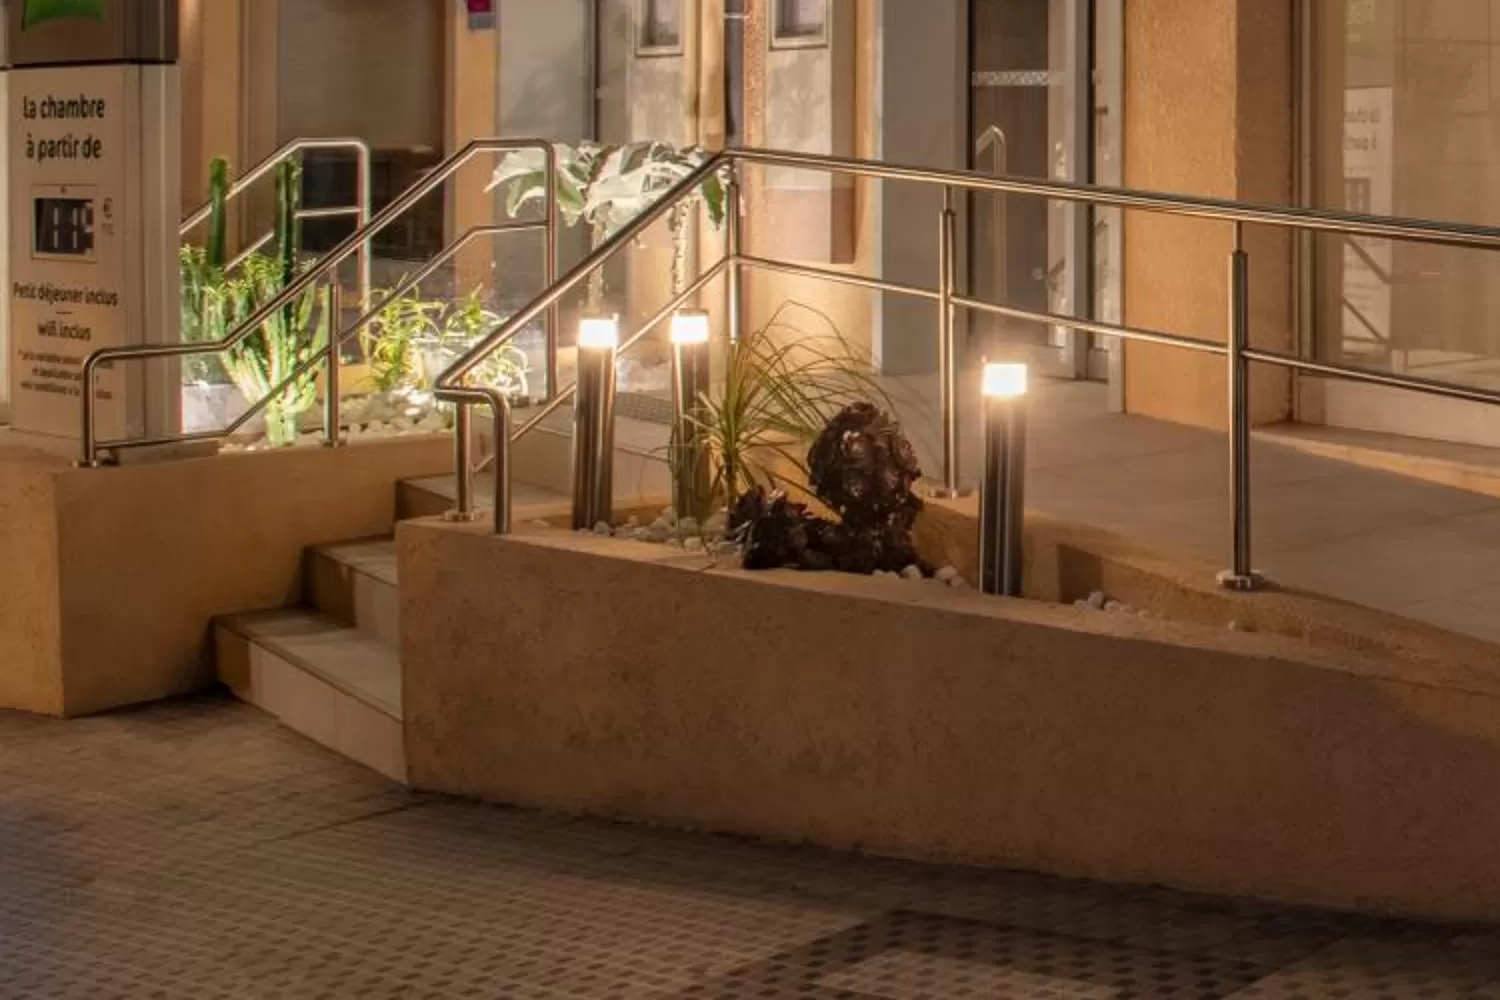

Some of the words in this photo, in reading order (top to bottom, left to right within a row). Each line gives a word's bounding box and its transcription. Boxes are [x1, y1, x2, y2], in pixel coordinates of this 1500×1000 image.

[40, 92, 105, 118] chambre
[26, 132, 35, 158] à
[38, 133, 80, 162] partir
[82, 133, 103, 159] de
[13, 281, 37, 299] Petit
[38, 280, 83, 305] déjeuner
[84, 285, 118, 306] inclus
[59, 320, 92, 341] inclus
